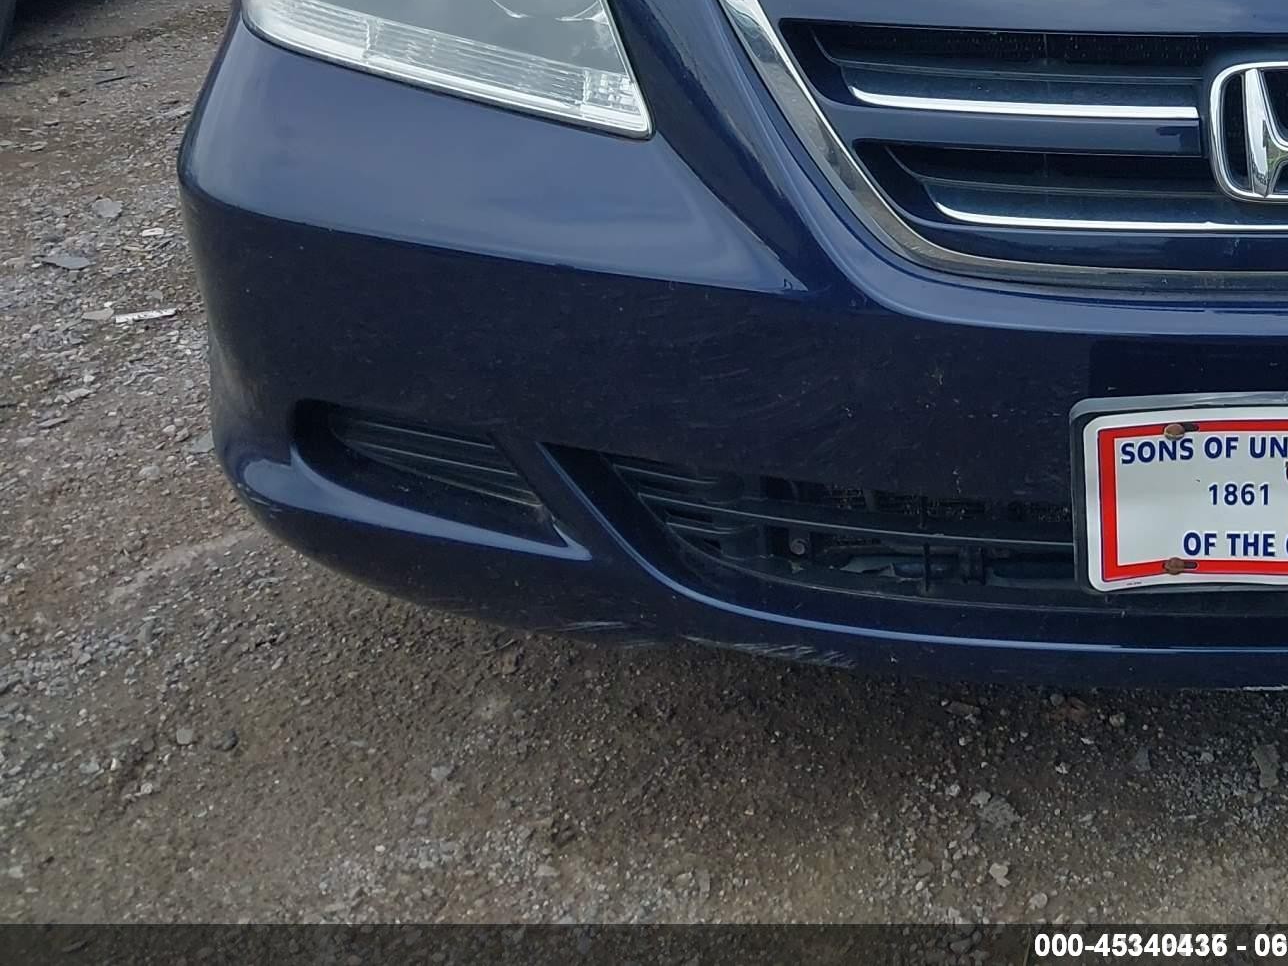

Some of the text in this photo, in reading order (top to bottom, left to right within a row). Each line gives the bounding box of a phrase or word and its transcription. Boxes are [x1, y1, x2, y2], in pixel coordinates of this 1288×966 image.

[1120, 439, 1195, 465] SONS
[1204, 437, 1239, 460] OF
[1208, 483, 1271, 507] 1861
[1183, 532, 1217, 557] OF
[1228, 533, 1275, 558] THE
